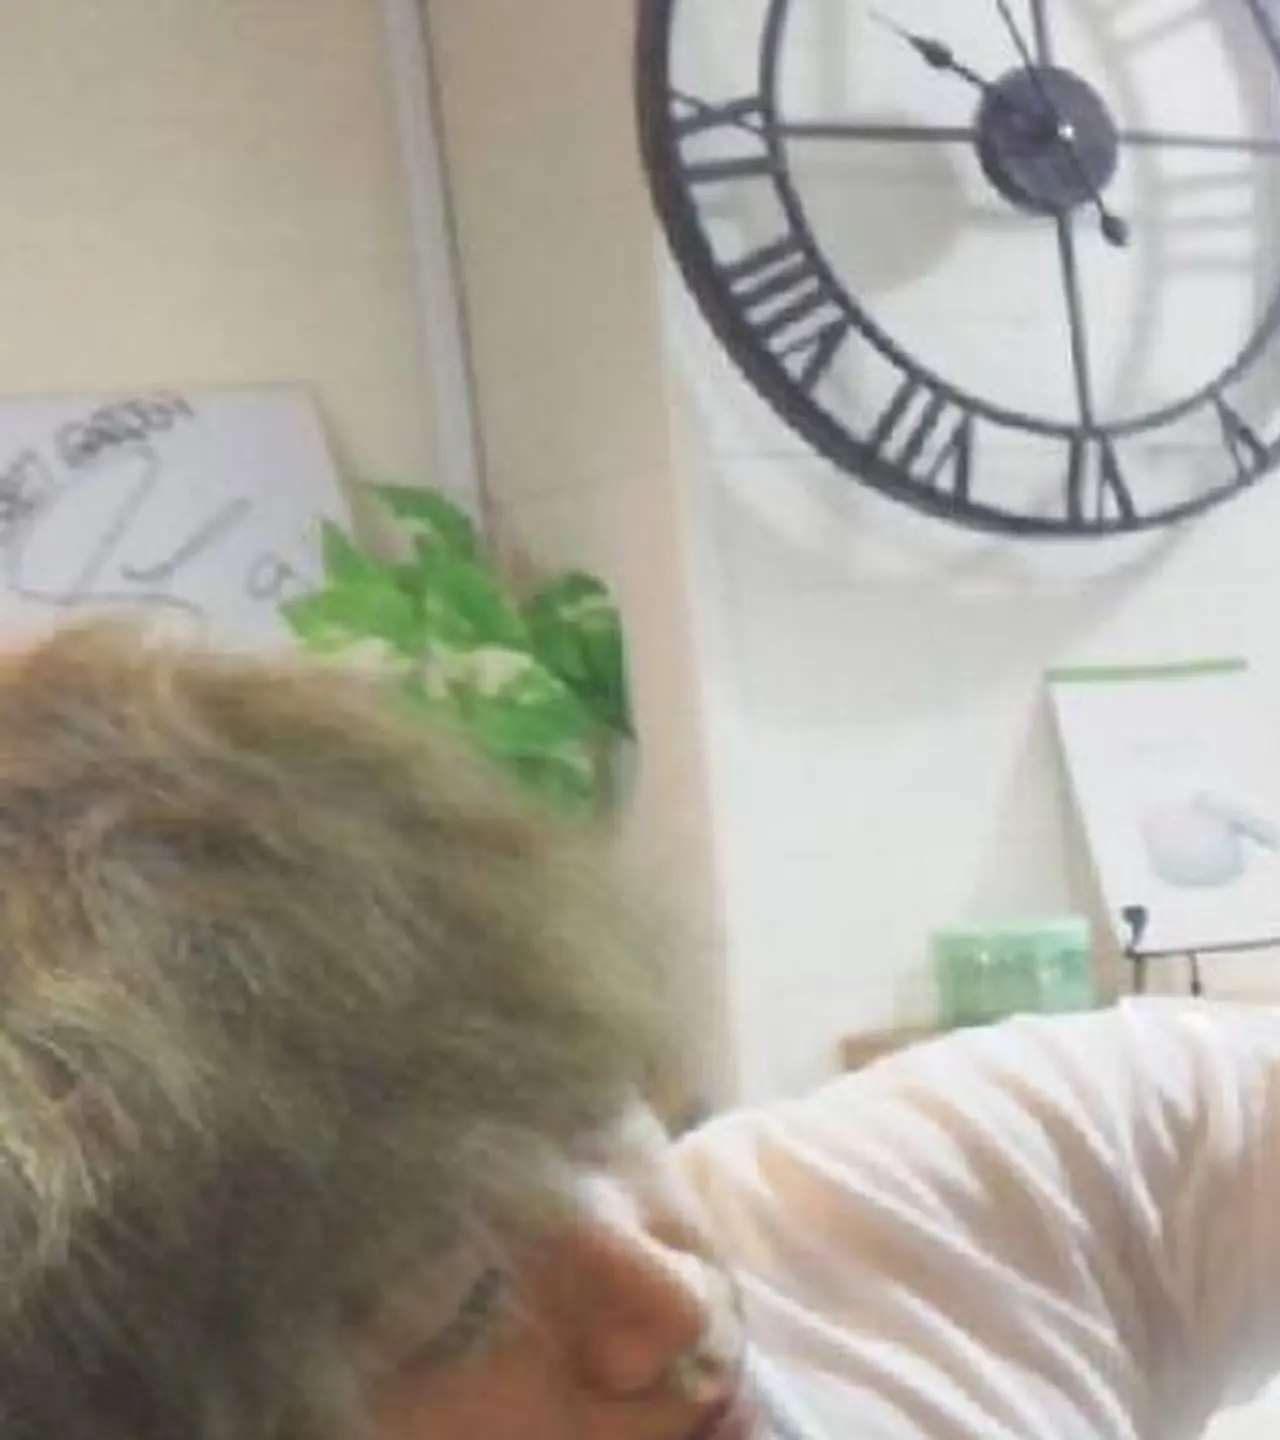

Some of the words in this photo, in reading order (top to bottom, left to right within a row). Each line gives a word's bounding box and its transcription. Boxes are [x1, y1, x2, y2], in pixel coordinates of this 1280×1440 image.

[712, 236, 852, 396] VIII
[868, 378, 974, 504] VII
[1067, 430, 1138, 522] VI
